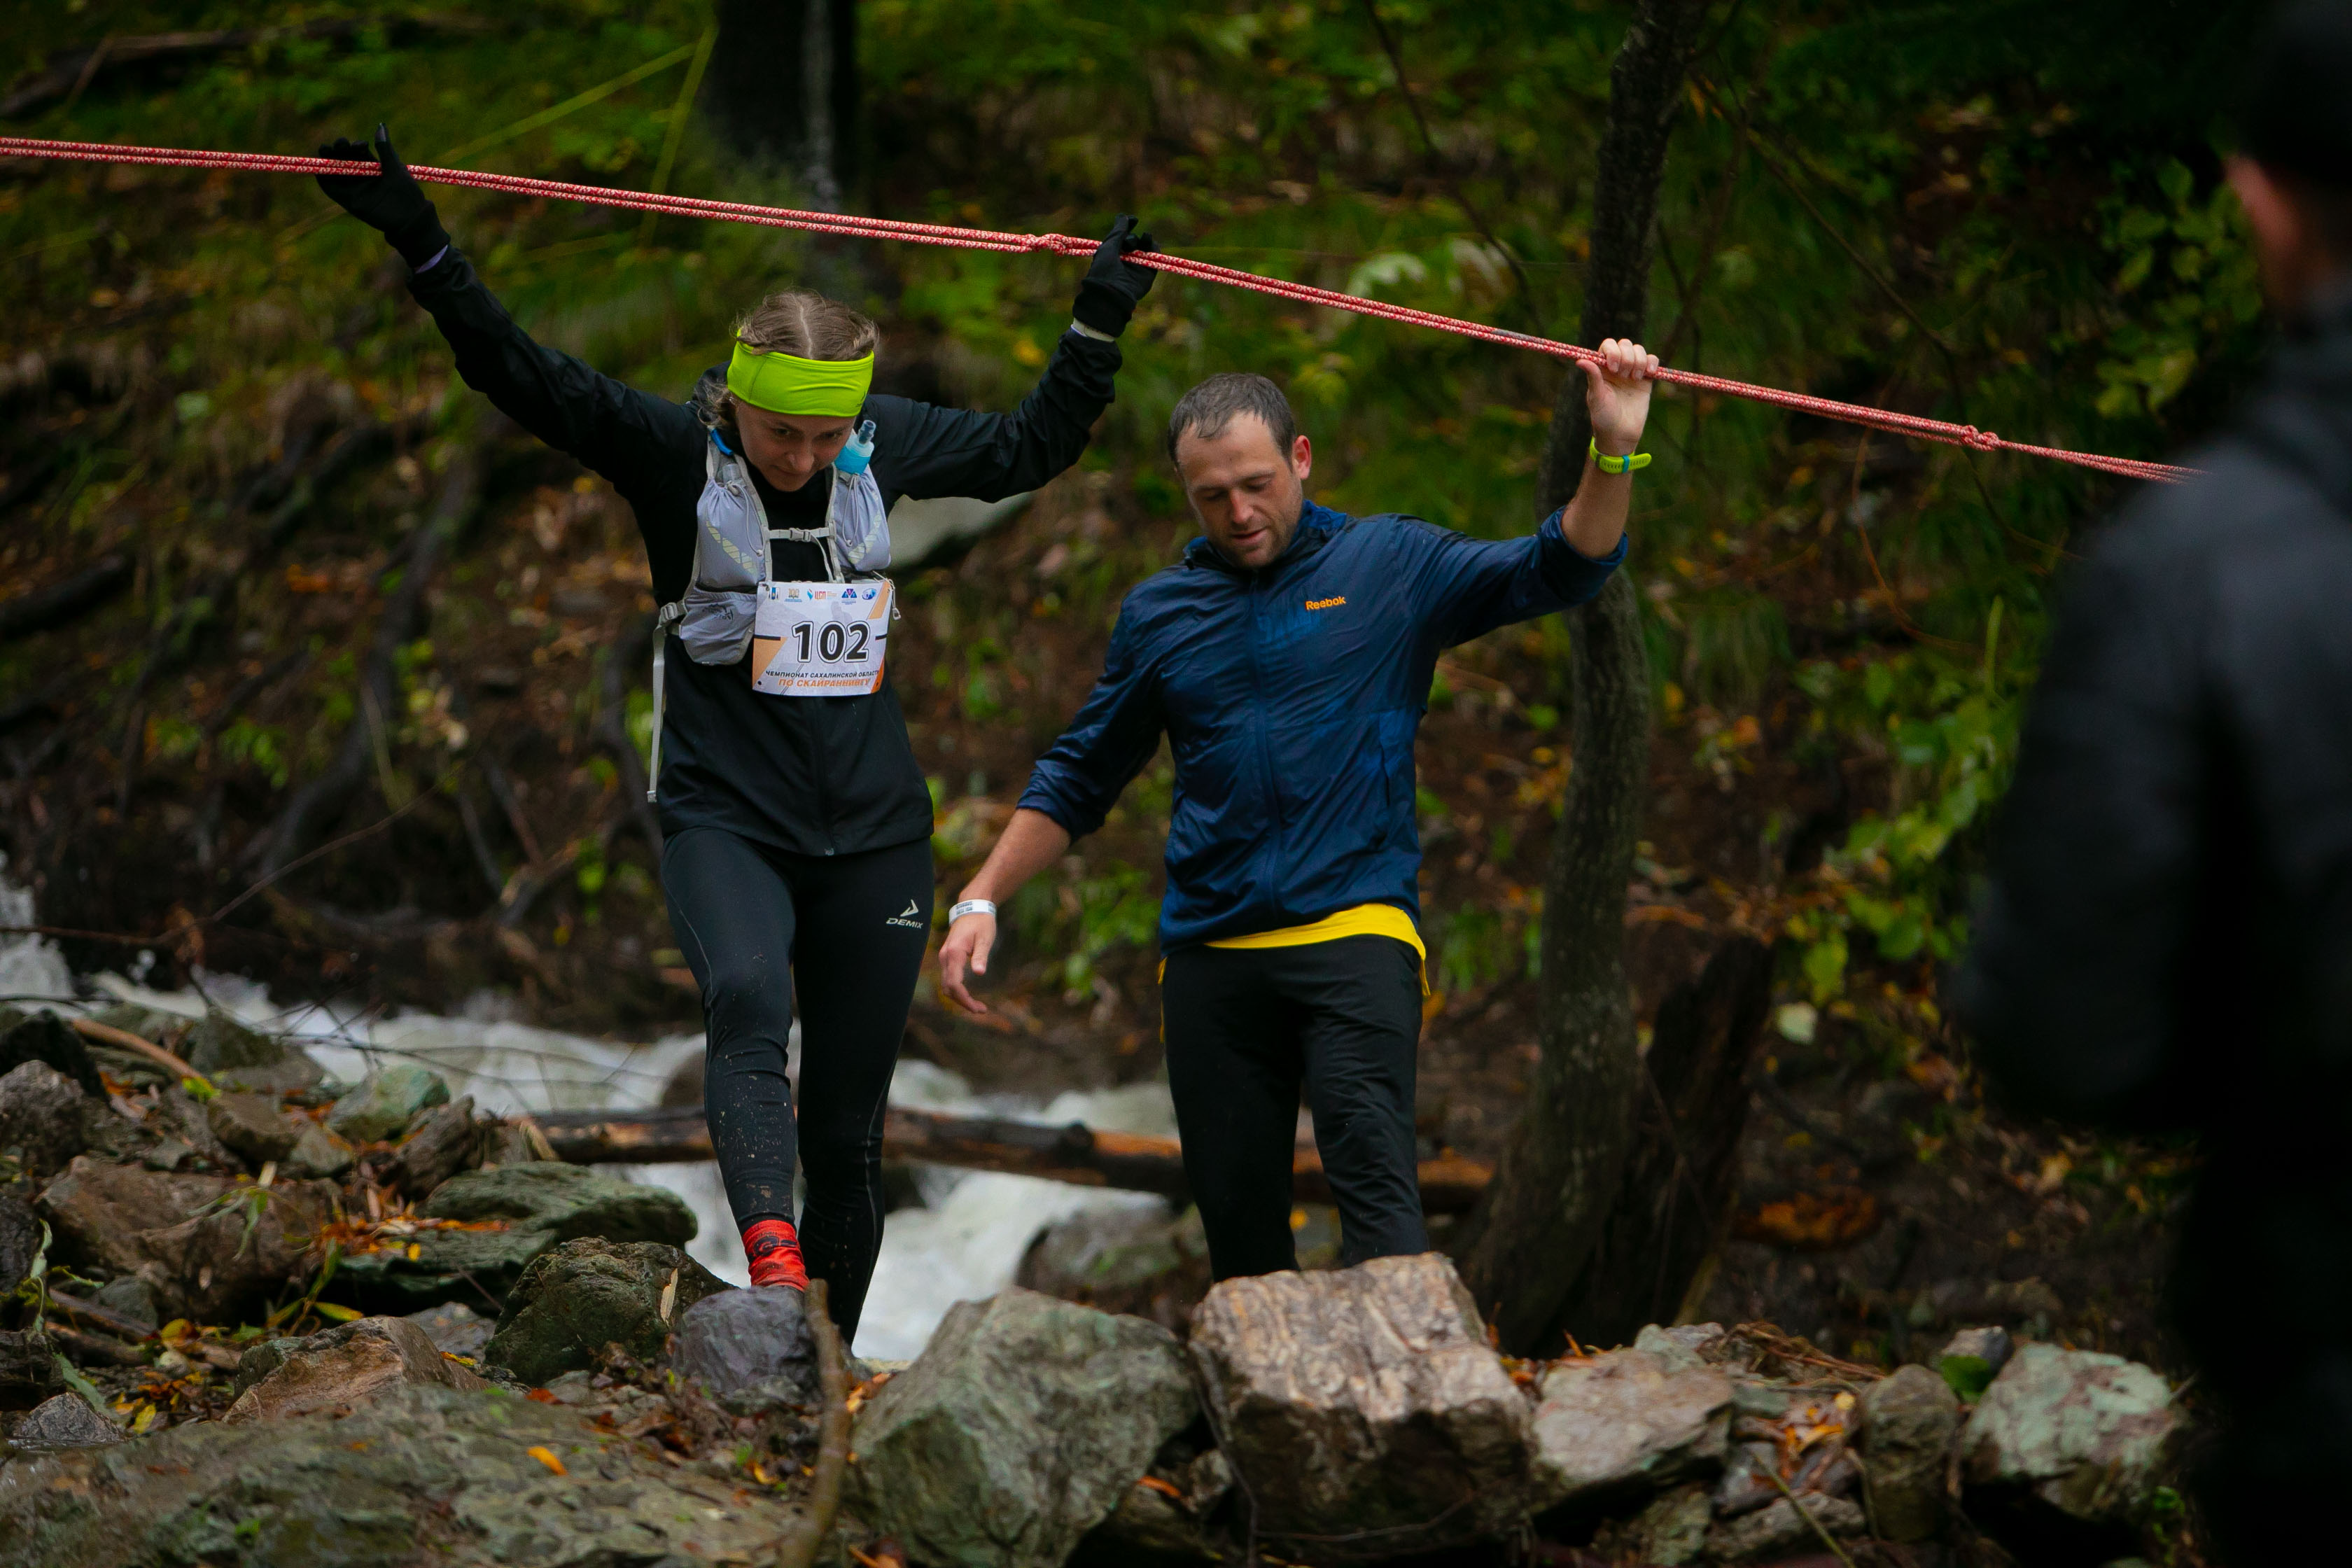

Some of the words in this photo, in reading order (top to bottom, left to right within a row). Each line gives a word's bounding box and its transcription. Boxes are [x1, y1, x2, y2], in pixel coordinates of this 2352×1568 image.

[1306, 596, 1346, 610] Reebok
[792, 621, 870, 663] 102
[766, 670, 808, 678] ЧЕМПИОНАТ
[797, 678, 870, 687] СКАЙРАННИНГУ
[886, 918, 923, 929] DEMIX
